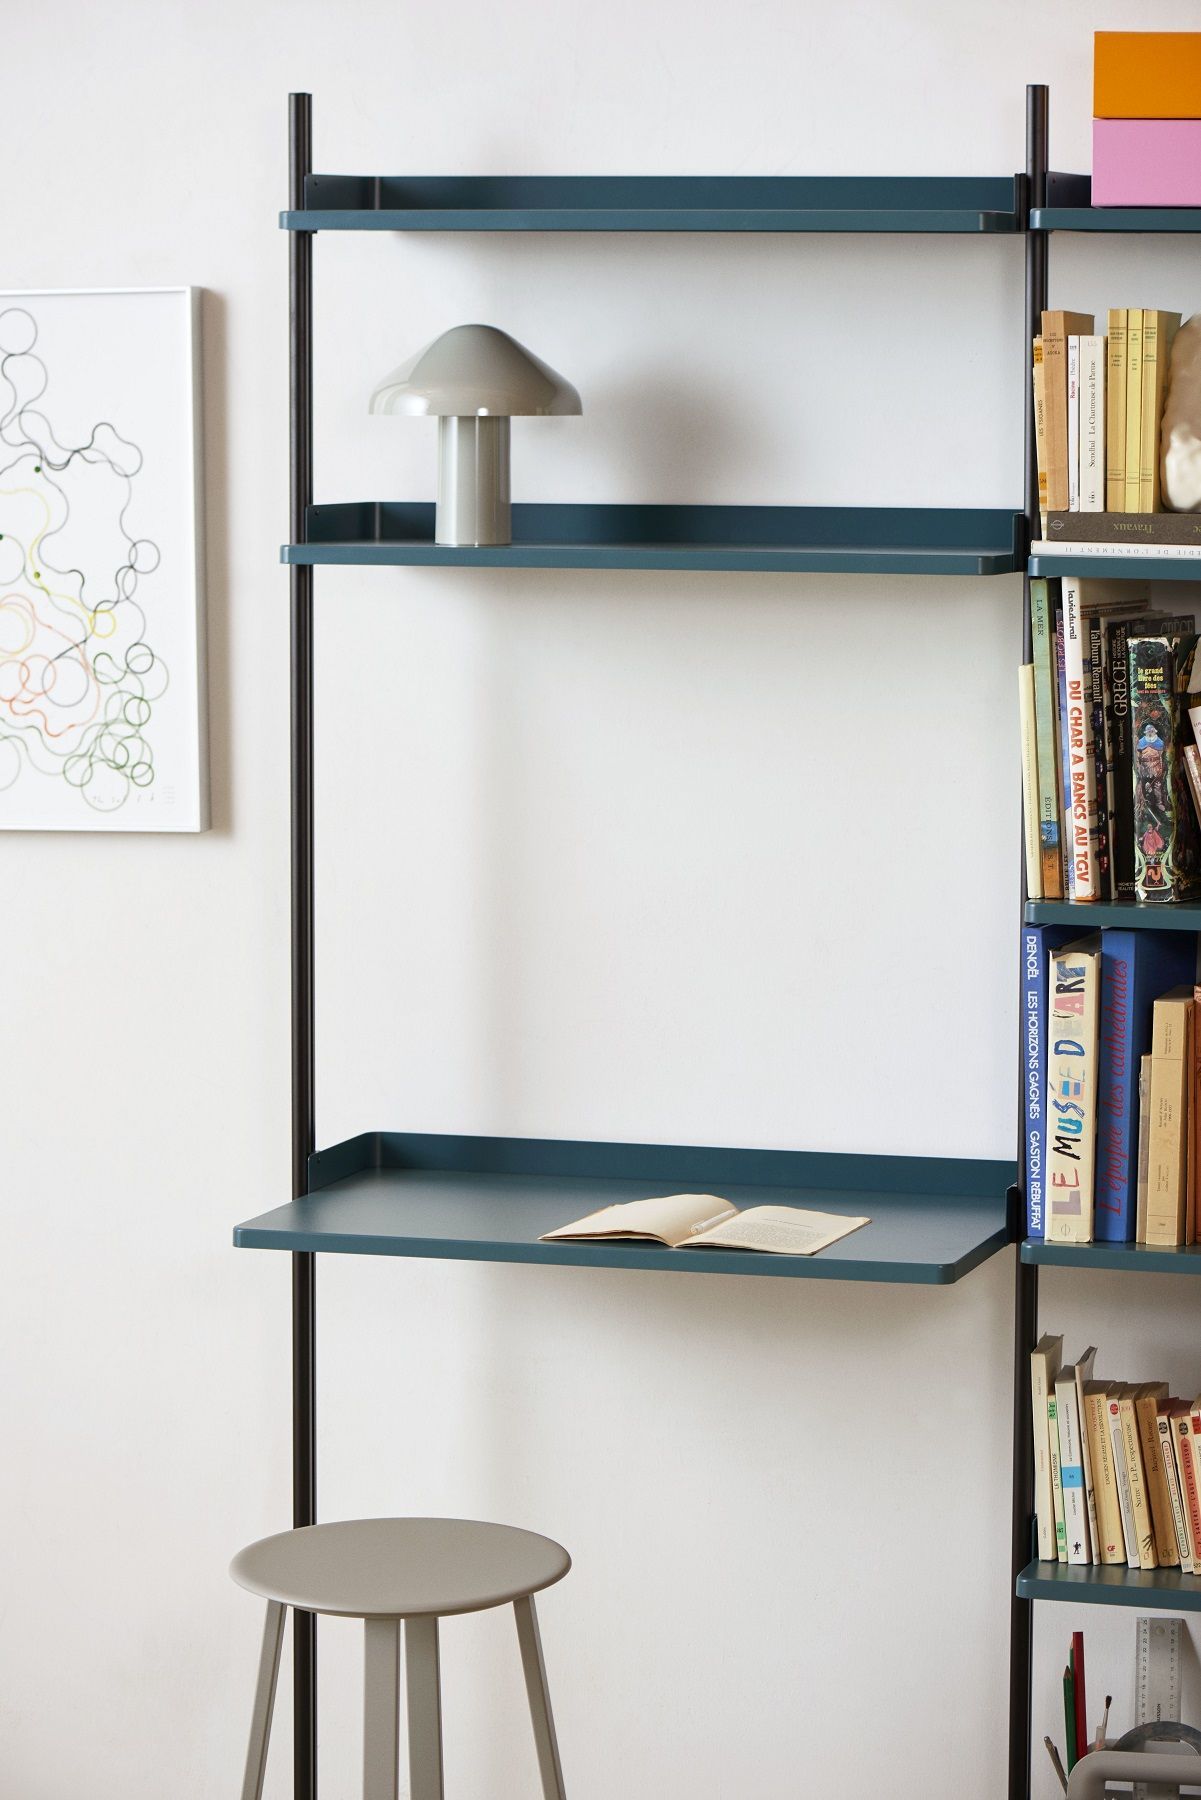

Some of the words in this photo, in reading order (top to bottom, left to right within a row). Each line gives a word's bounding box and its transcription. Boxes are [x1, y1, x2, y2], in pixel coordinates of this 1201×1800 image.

[1088, 360, 1096, 380] Parme
[1088, 381, 1096, 390] de
[1088, 391, 1096, 425] Chartreuse
[1089, 425, 1096, 435] La
[1113, 523, 1155, 534] Travaux
[1081, 546, 1149, 554] L'ORNEMENT
[1036, 599, 1043, 612] LA
[1036, 615, 1044, 636] MER
[1056, 620, 1065, 657] ROBOTS
[1090, 630, 1101, 665] l'album
[1058, 660, 1066, 672] LES
[1137, 674, 1152, 682] livre
[1152, 674, 1164, 682] des
[1144, 667, 1163, 676] grand
[1068, 680, 1082, 701] DU
[1092, 667, 1103, 703] Renault
[1112, 660, 1128, 716] GRECE
[1069, 706, 1084, 749] CHAR
[1071, 753, 1084, 766] A
[1072, 772, 1087, 820] BANCS
[1074, 825, 1088, 847] AU
[1075, 851, 1090, 883] TGV
[1026, 936, 1040, 981] DENOËL
[1027, 991, 1038, 1009] LES
[1103, 959, 1128, 1077] cathédrales
[1028, 1011, 1039, 1069] HORIZONS
[1029, 1071, 1040, 1120] GAGNÉS
[1103, 1083, 1125, 1118] des
[1049, 1066, 1085, 1160] MUSÉE
[1030, 1130, 1041, 1179] GASTON
[1100, 1125, 1129, 1216] L'épopée
[1051, 1167, 1082, 1216] LE
[1030, 1181, 1042, 1230] RÉBUFFAT
[1126, 1423, 1137, 1463] respectueuse
[1183, 1443, 1192, 1469] RAISON
[1150, 1446, 1159, 1472] Barjavel
[1131, 1472, 1139, 1482] La
[1186, 1471, 1193, 1480] DE
[1134, 1488, 1143, 1508] Sartre
[1192, 1509, 1201, 1535] SARTRE
[1178, 1526, 1187, 1553] ALPHONSE
